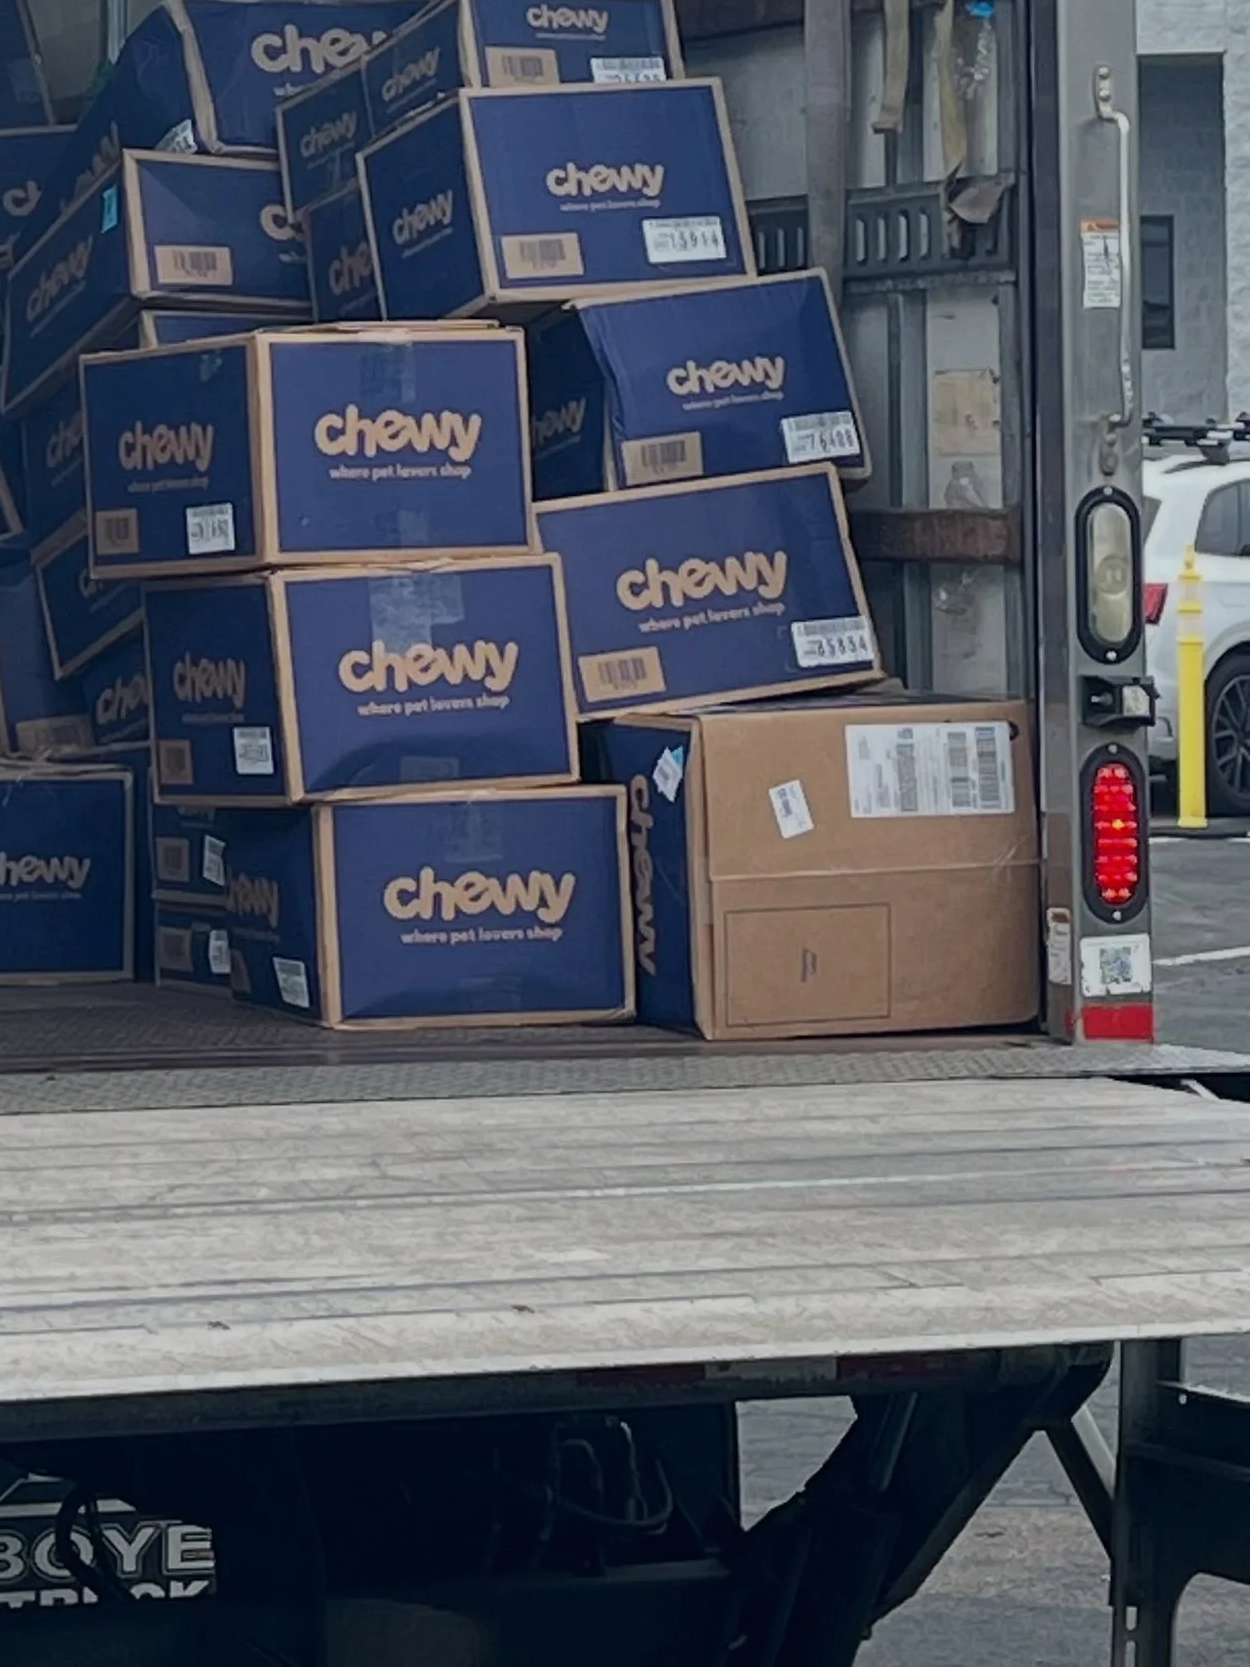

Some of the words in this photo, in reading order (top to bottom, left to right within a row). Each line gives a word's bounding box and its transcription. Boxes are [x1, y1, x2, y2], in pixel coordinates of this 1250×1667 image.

[527, 4, 609, 33] chewy
[251, 24, 388, 74] che
[546, 162, 664, 197] chewy
[392, 189, 453, 245] chewy
[328, 241, 372, 296] che
[667, 355, 785, 397] chewy
[314, 403, 482, 462] chewy
[533, 397, 586, 438] hewy
[118, 420, 214, 473] chewy
[617, 550, 788, 612] chewy
[173, 651, 247, 709] chewy
[338, 638, 519, 693] chewy
[383, 866, 577, 924] chewy
